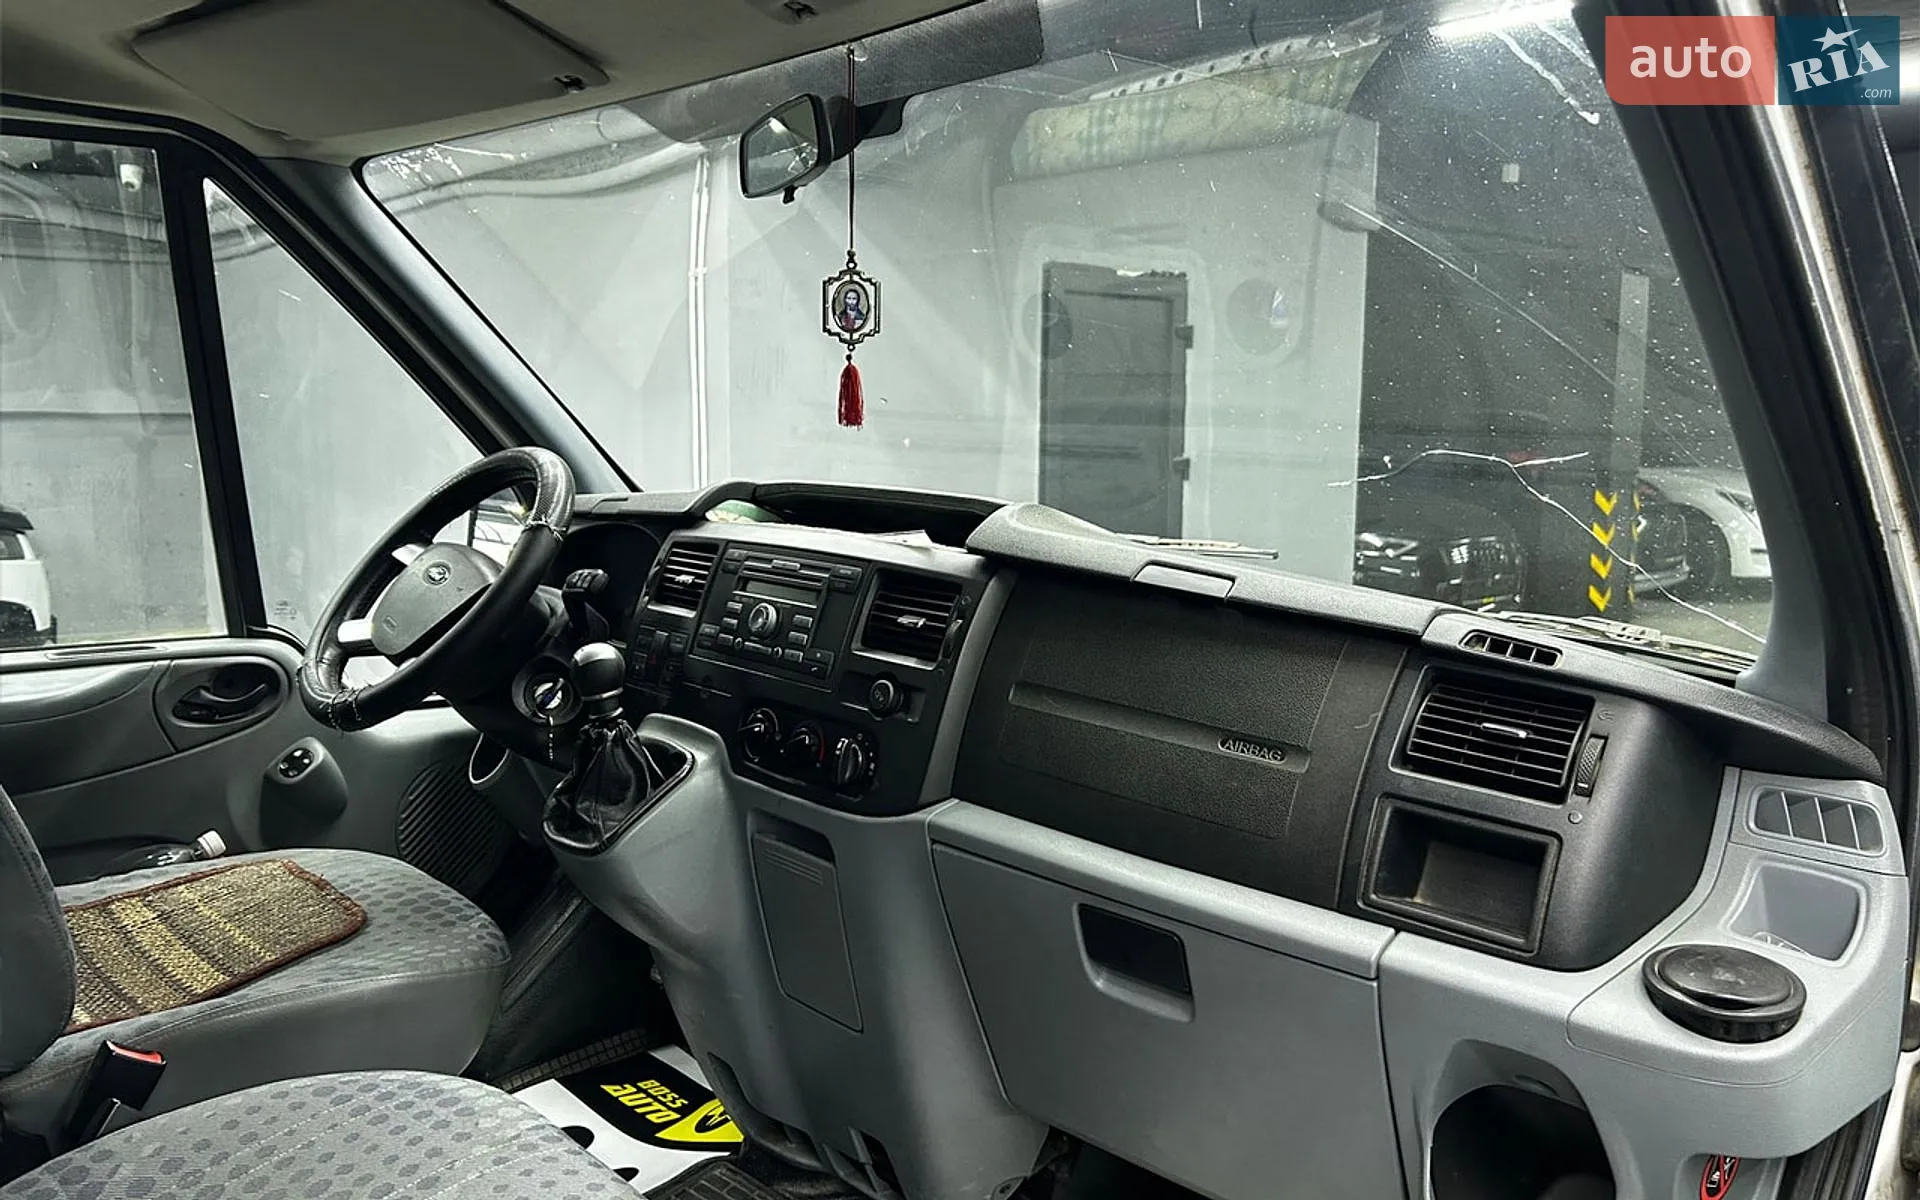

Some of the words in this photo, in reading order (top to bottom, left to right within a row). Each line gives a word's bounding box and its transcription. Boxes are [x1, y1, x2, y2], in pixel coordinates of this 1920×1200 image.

[1223, 739, 1283, 761] AIRBAG
[600, 1083, 681, 1124] AUTO
[636, 1079, 688, 1109] BOSS
